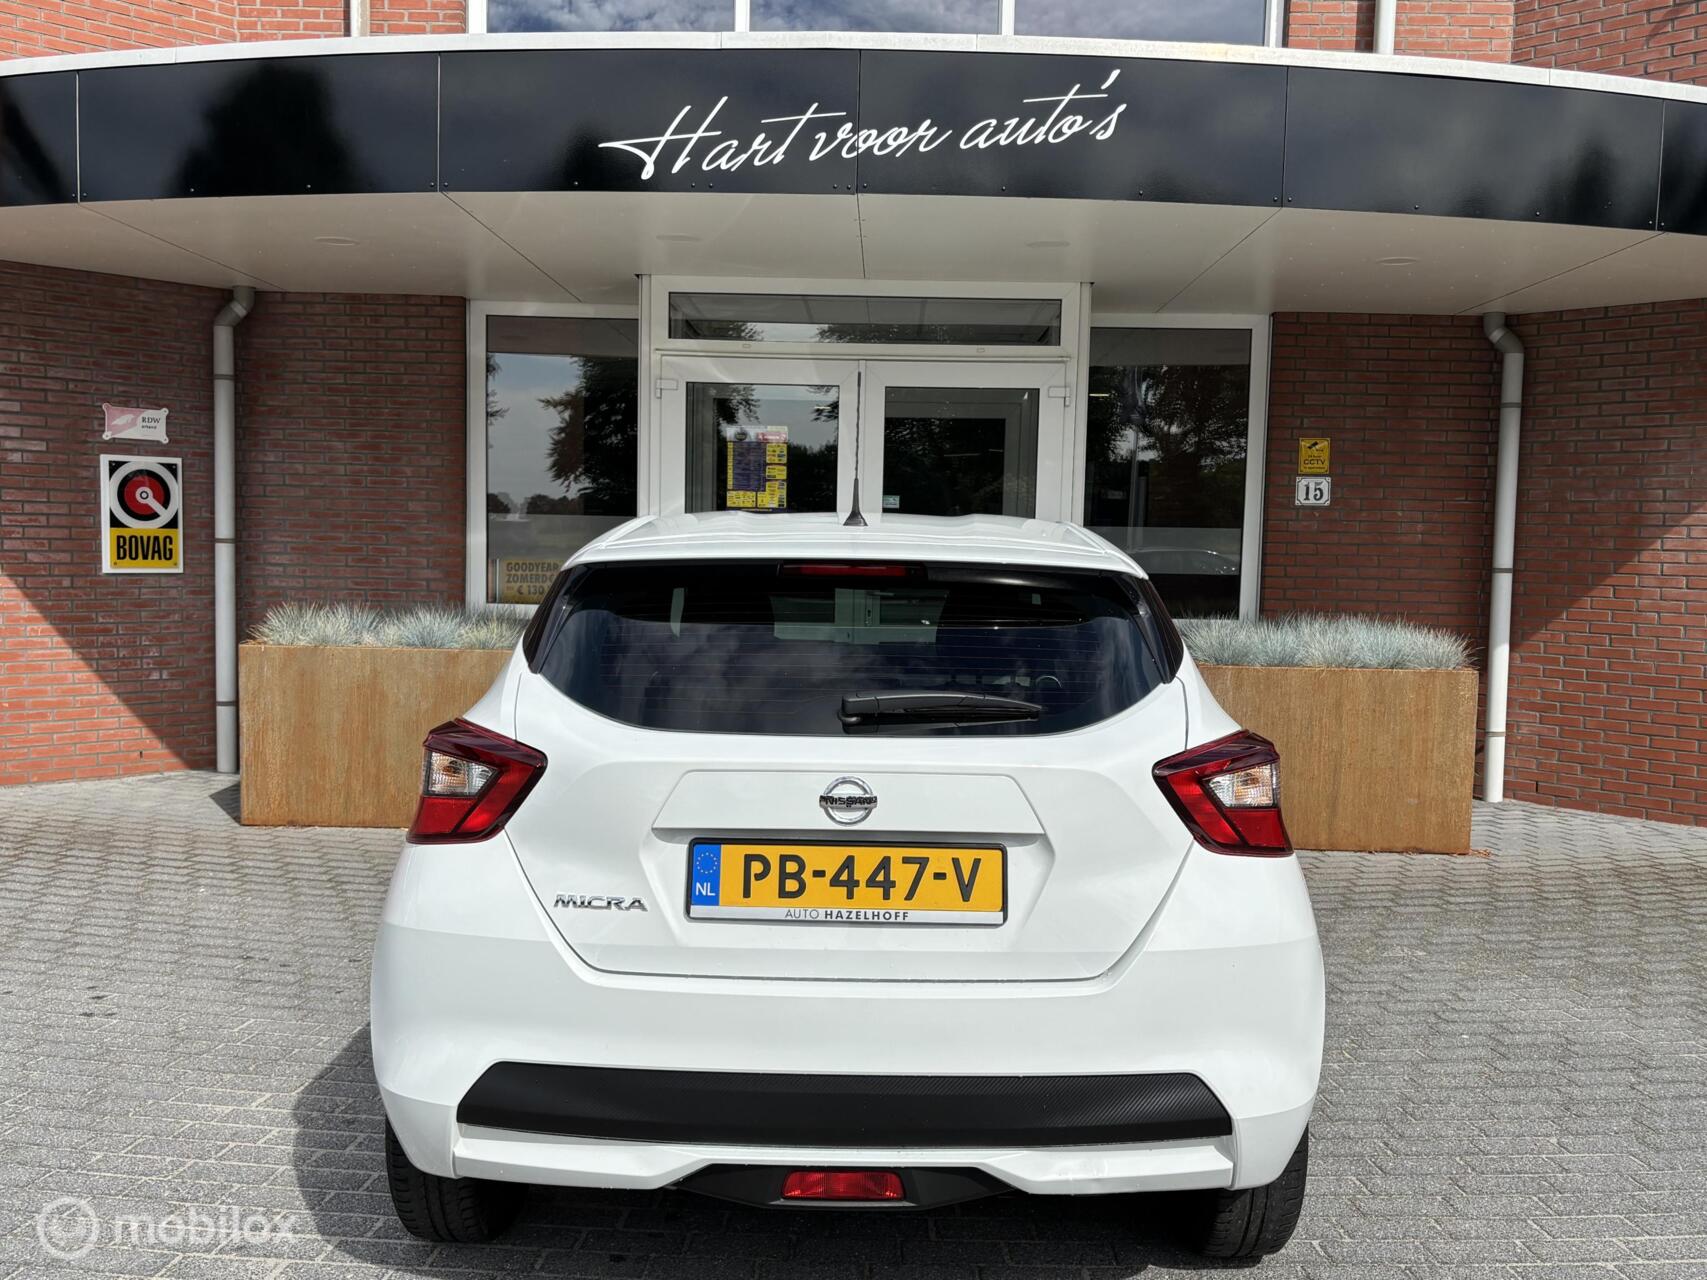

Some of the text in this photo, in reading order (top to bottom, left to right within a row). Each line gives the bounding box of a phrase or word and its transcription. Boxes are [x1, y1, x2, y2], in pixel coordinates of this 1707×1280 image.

[600, 69, 1128, 181] Hart voor auto's
[141, 416, 161, 424] RDW
[1303, 481, 1324, 501] 15
[116, 534, 173, 561] BOVAG
[527, 585, 545, 595] 130
[822, 795, 875, 806] NISSAN
[742, 853, 982, 902] PB-447-V
[695, 882, 716, 897] NL
[554, 894, 648, 912] MICRA
[784, 908, 910, 921] AUTO HAZELHOFF
